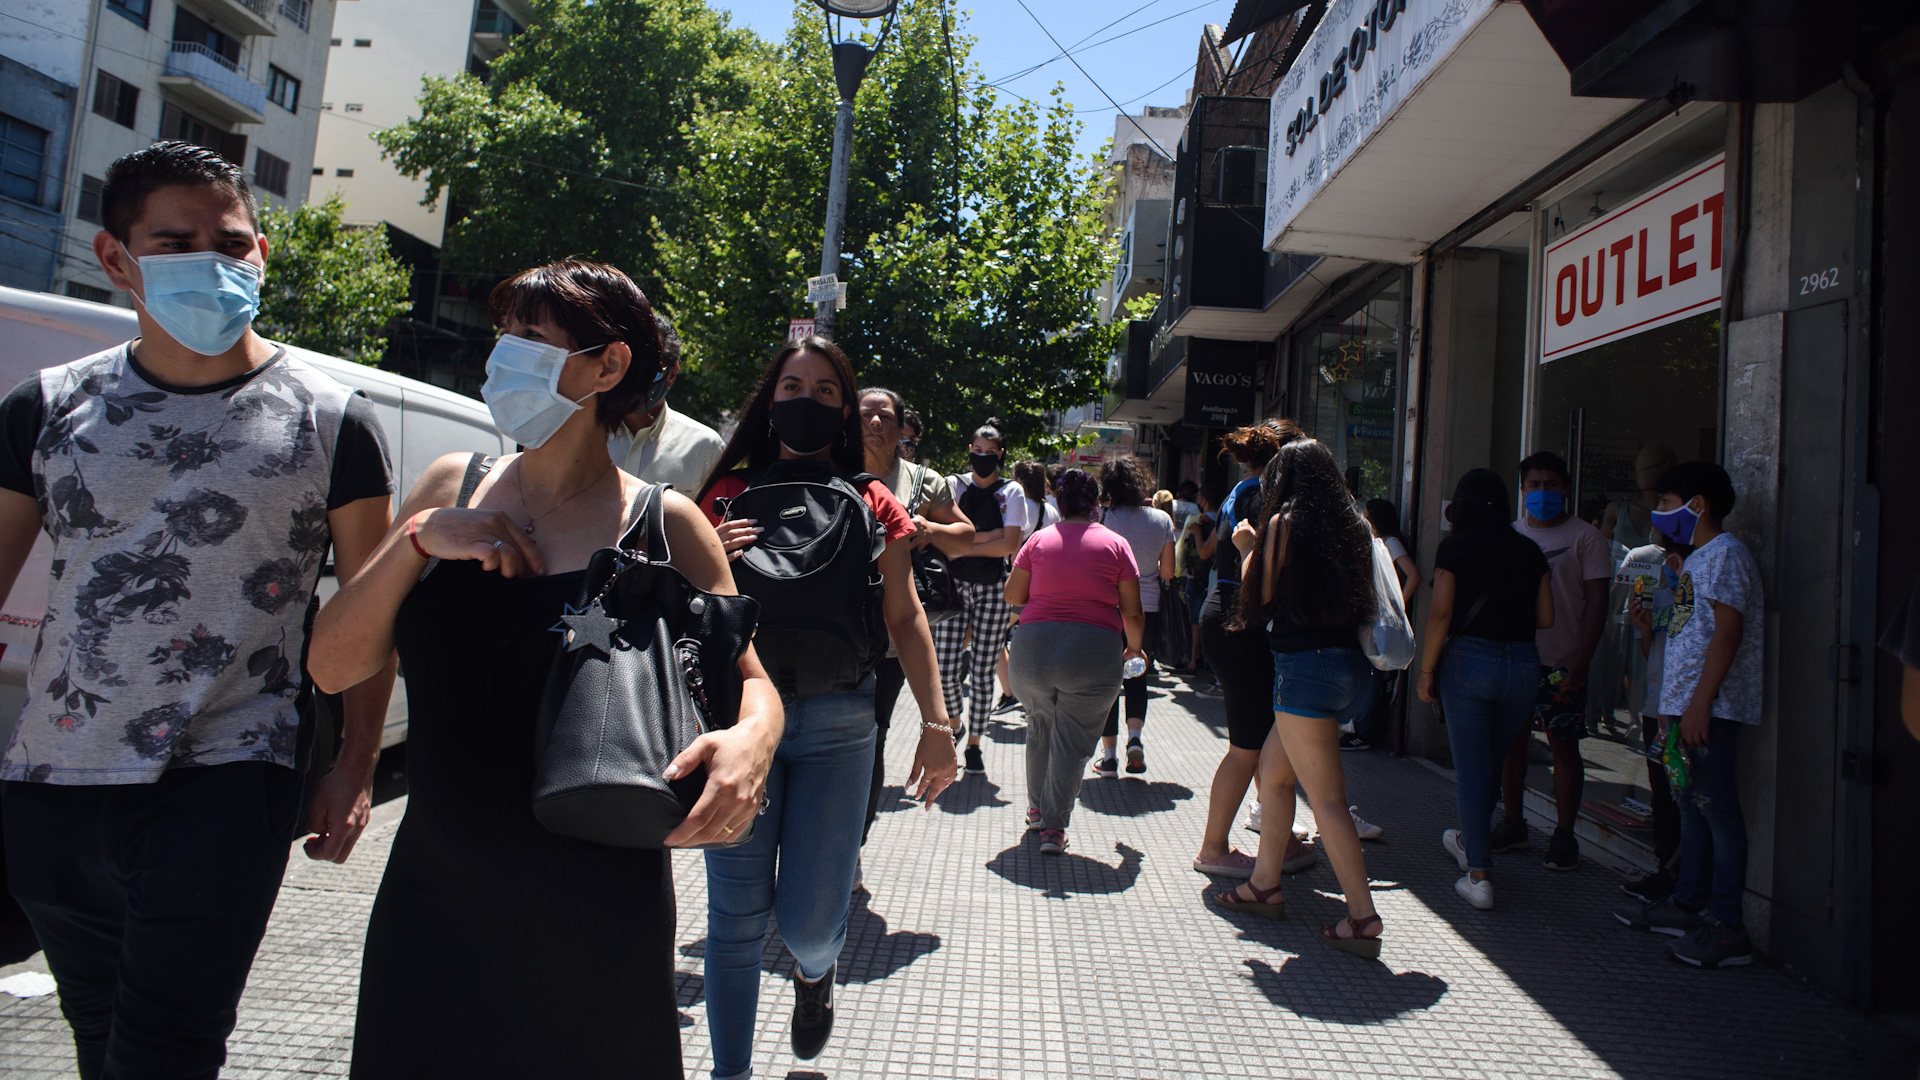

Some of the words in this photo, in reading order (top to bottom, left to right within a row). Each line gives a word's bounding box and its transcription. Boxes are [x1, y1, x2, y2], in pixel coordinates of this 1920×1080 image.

[1285, 96, 1318, 156] SOL
[1318, 46, 1348, 115] DE
[1555, 191, 1725, 327] OUTLET
[1799, 267, 1840, 296] 2962
[1201, 404, 1238, 415] Avellaneda
[1211, 413, 1228, 421] 295
